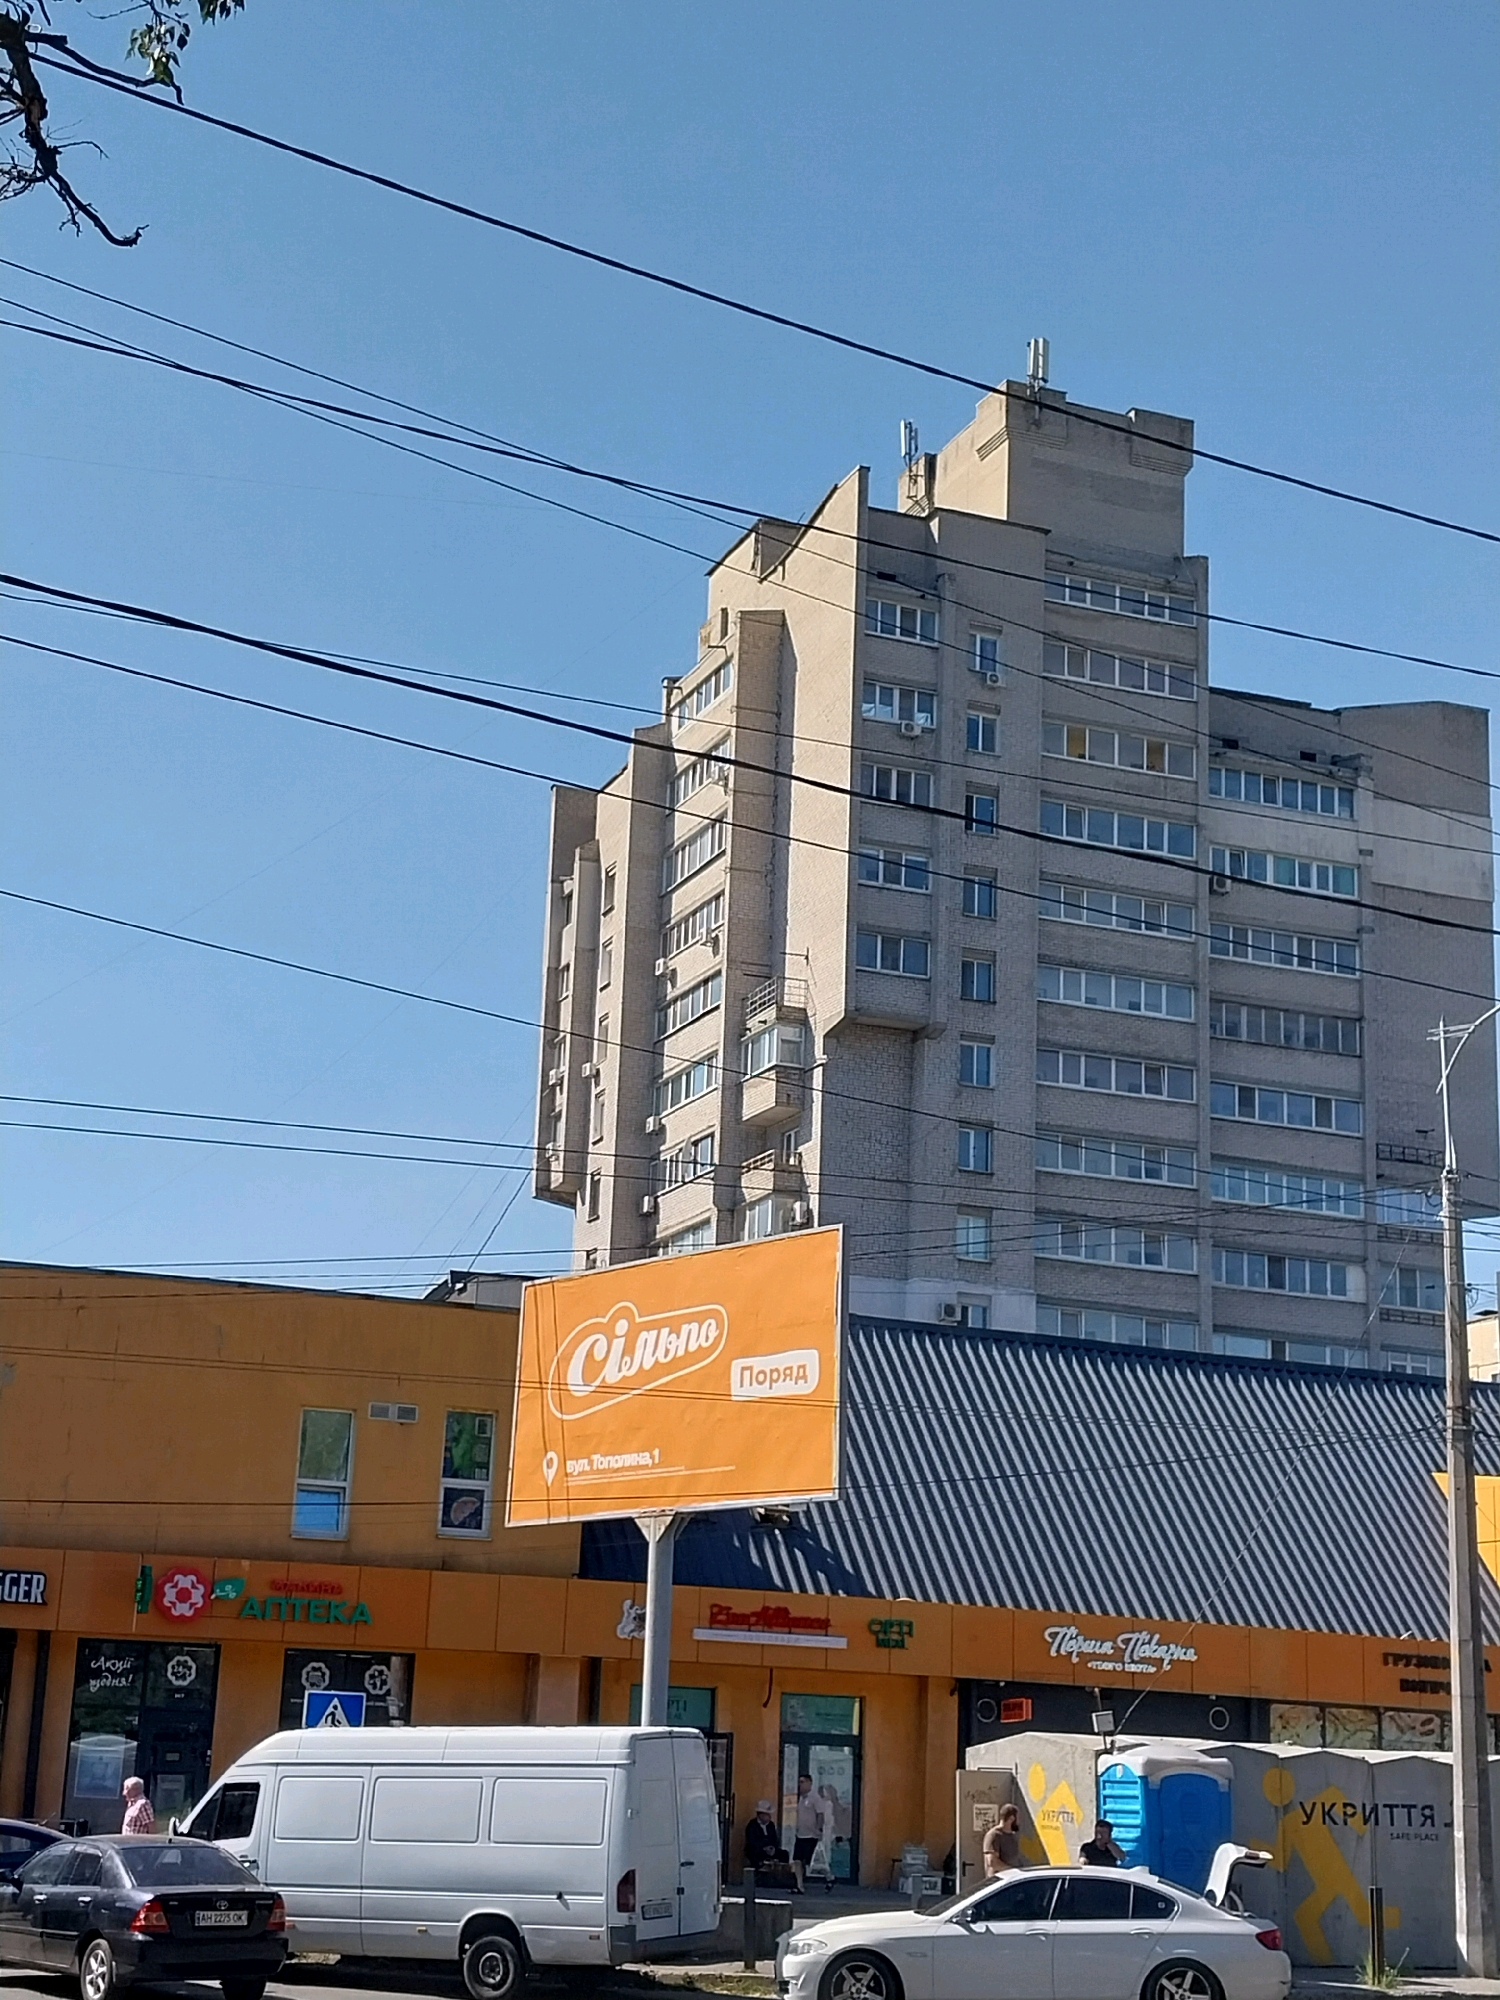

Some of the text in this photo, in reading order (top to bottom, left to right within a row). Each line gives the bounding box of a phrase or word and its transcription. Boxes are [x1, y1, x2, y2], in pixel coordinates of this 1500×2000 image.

[567, 1319, 719, 1396] Сільпо
[739, 1361, 809, 1390] Поряд
[566, 1459, 590, 1475] вул.
[0, 1572, 45, 1604] GER
[240, 1596, 373, 1625] АПТЕКА
[1117, 1631, 1198, 1671] Пекарня
[1299, 1800, 1436, 1828] УКРИТТЯ
